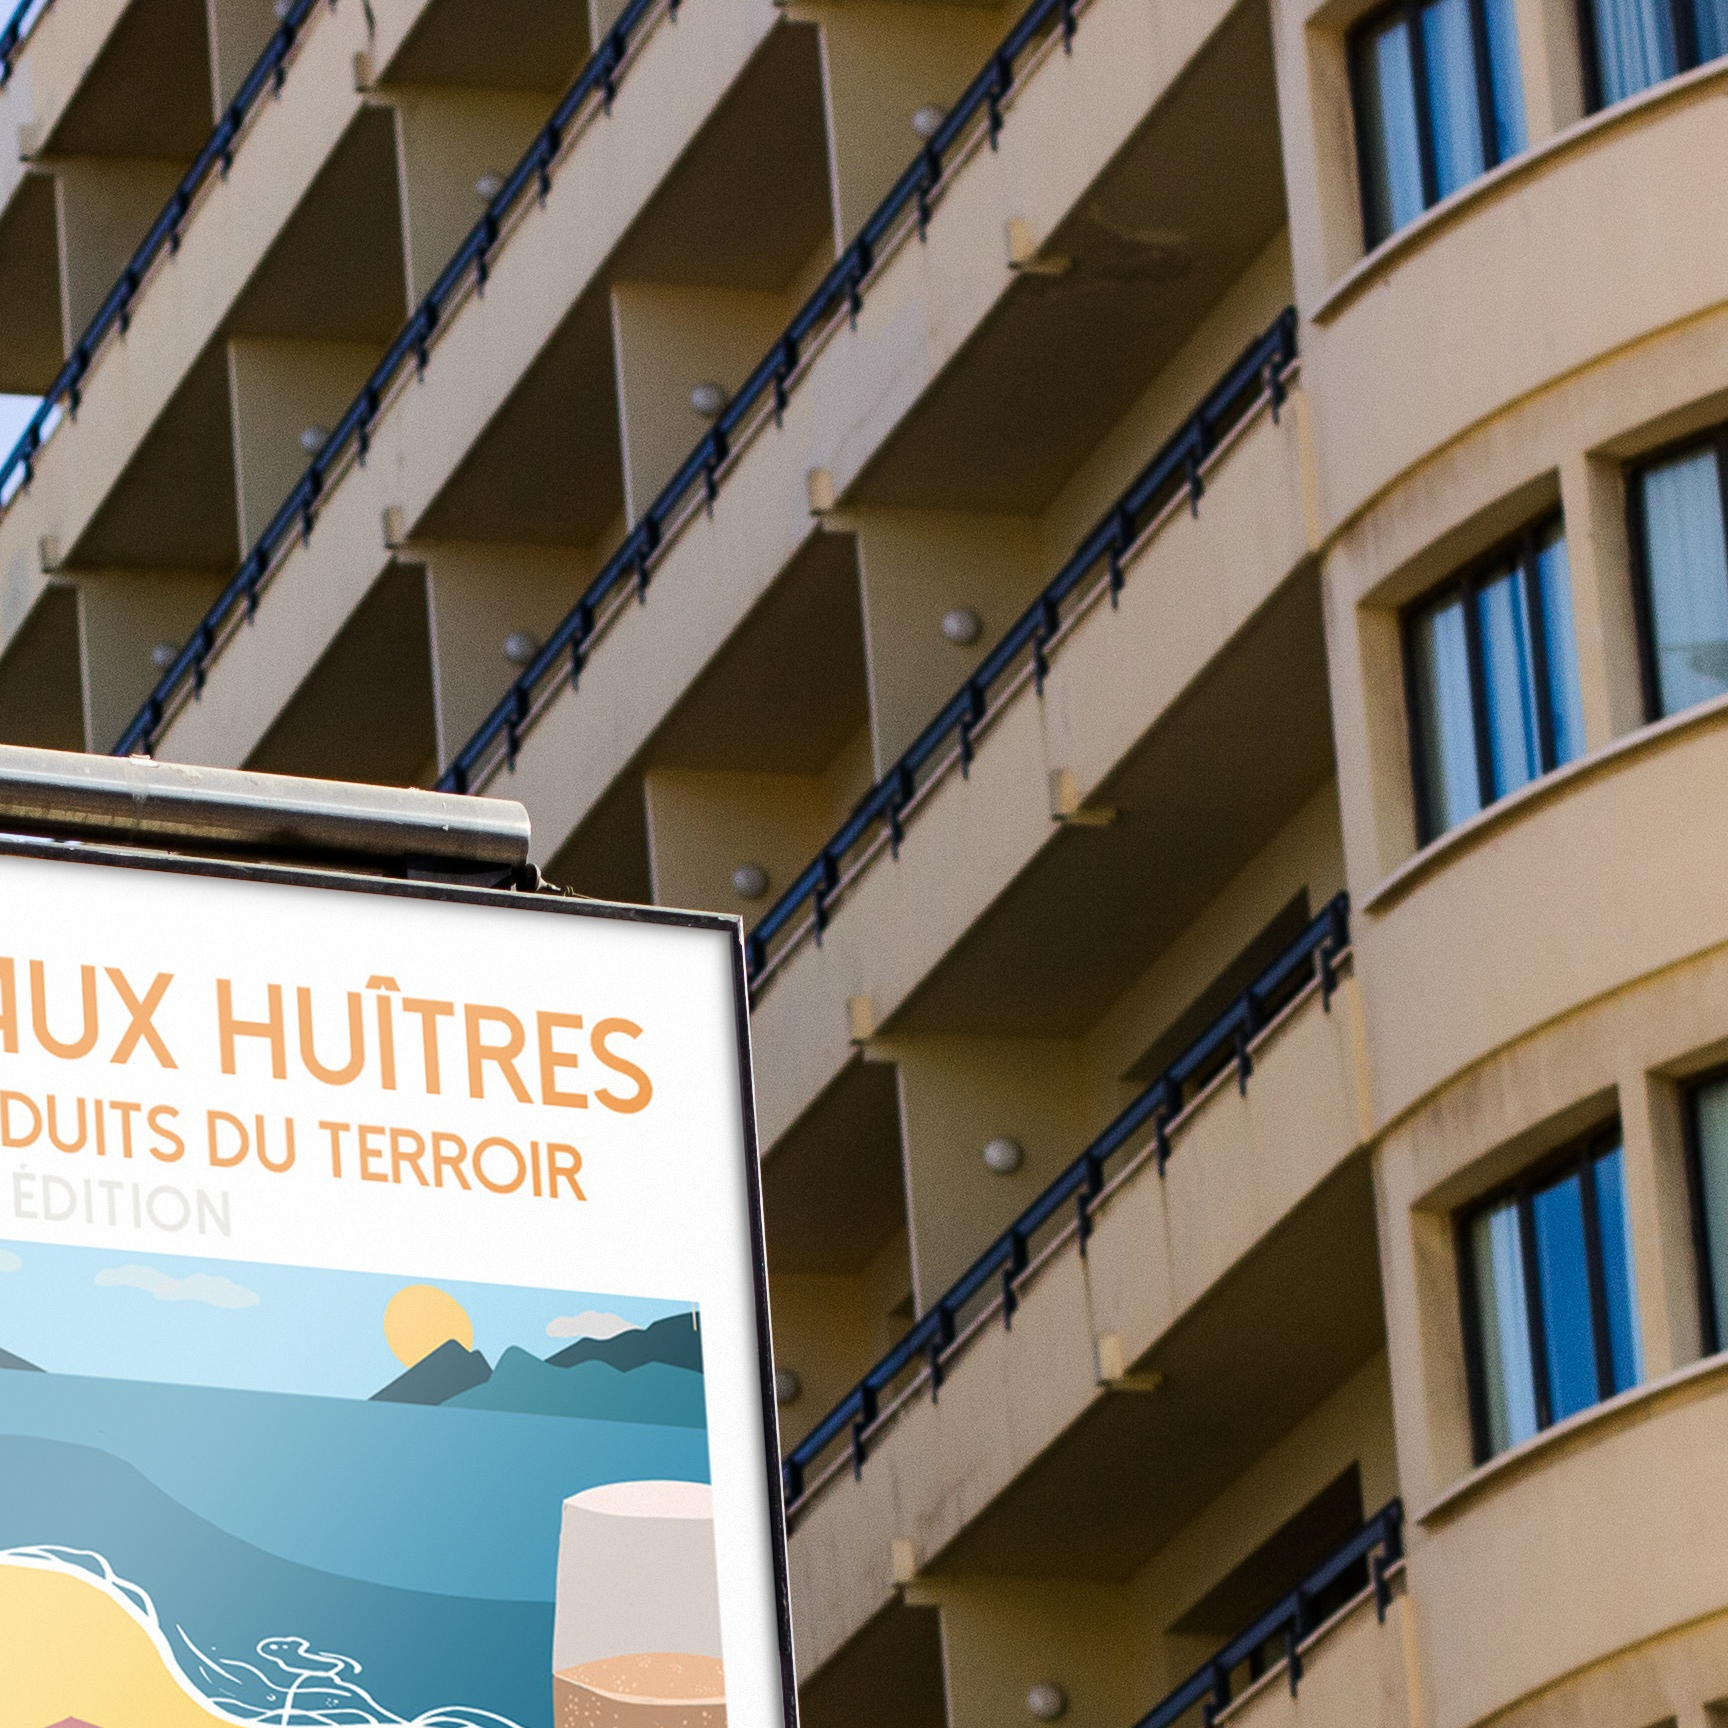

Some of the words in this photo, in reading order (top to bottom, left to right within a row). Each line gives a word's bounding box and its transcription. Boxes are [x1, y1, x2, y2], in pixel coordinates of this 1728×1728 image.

[215, 976, 654, 1115] HUÎTRES
[12, 1163, 232, 1237] ÉDITION
[206, 1112, 296, 1173] DU
[318, 1120, 587, 1202] TERROIR
